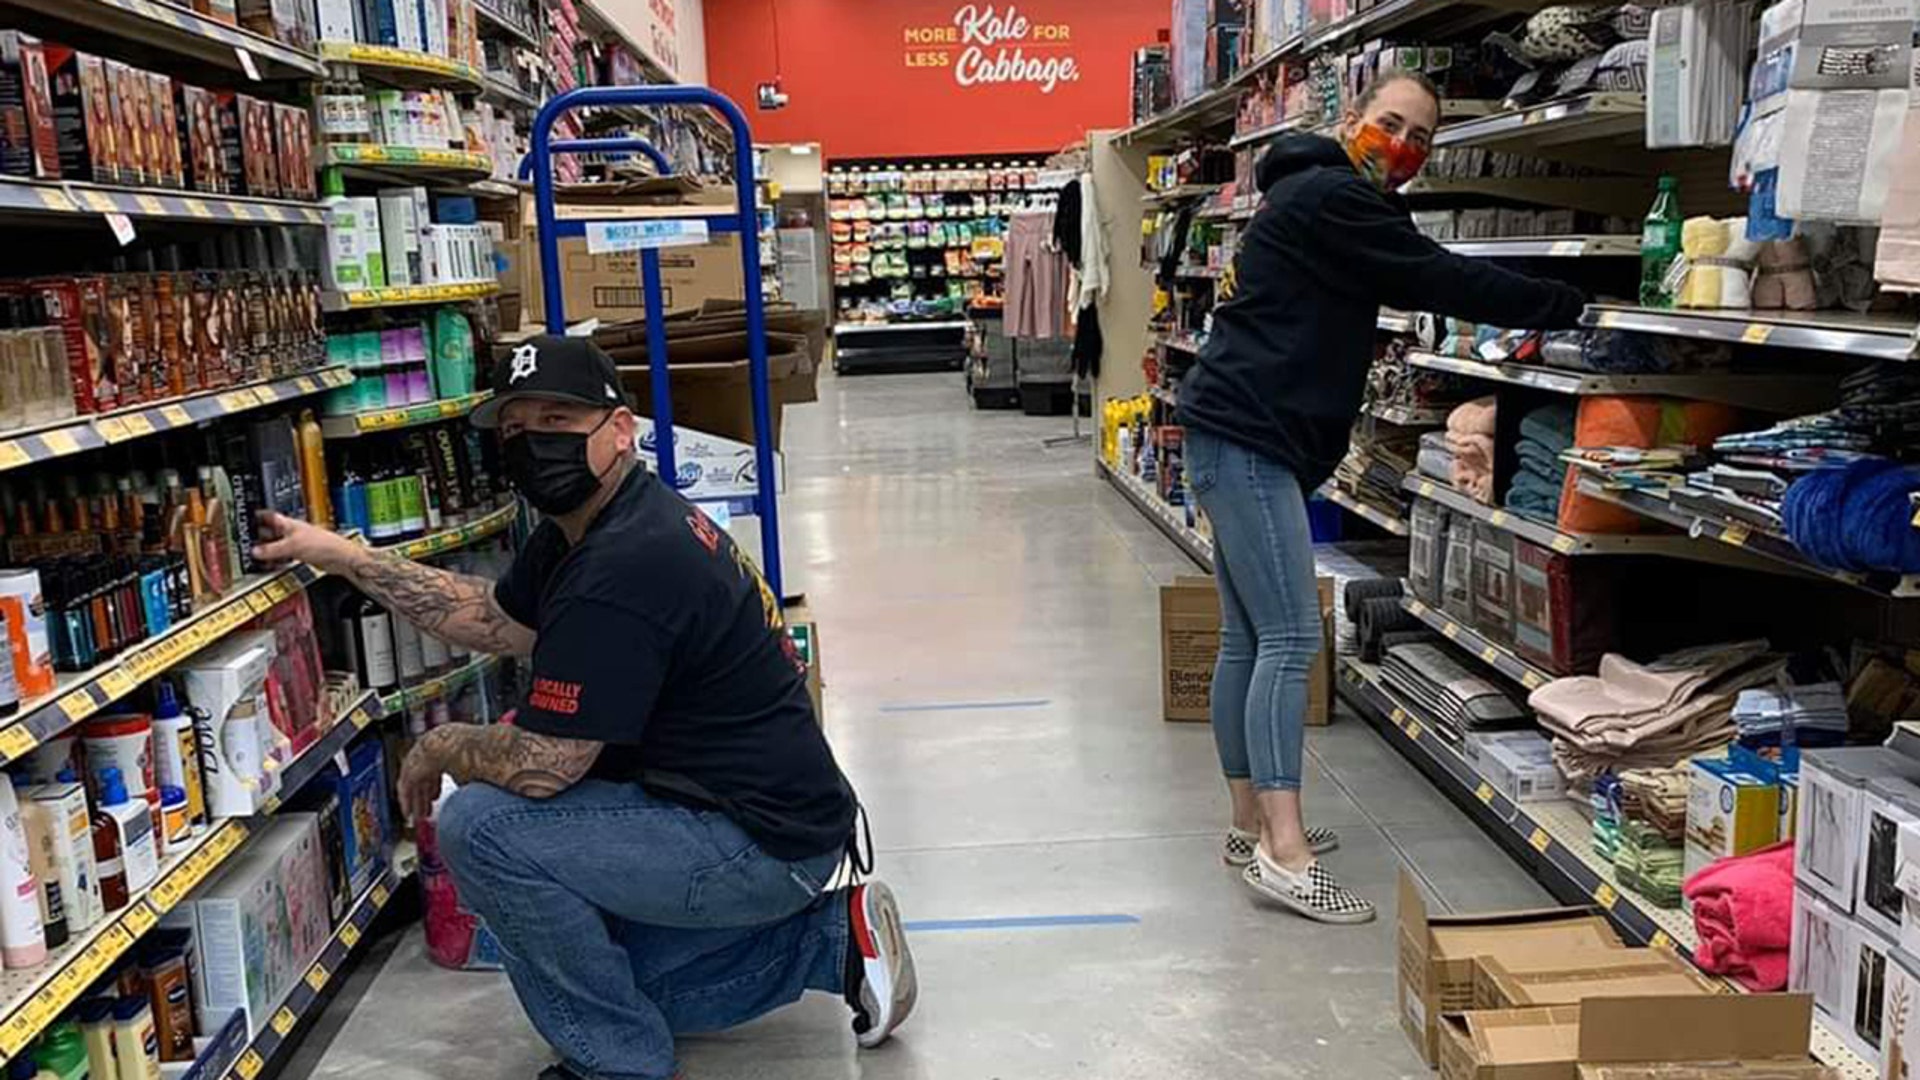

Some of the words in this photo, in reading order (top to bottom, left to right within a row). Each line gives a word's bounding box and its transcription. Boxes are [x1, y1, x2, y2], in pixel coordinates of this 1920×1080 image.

[904, 27, 957, 43] MORE
[954, 4, 1029, 45] Kale
[1033, 25, 1070, 39] FOR
[905, 52, 949, 66] LESS
[955, 47, 1080, 93] Cabbage.
[509, 344, 538, 384] D
[529, 693, 578, 714] OWNED
[534, 679, 581, 698] LOCALLY
[193, 706, 219, 774] Dove
